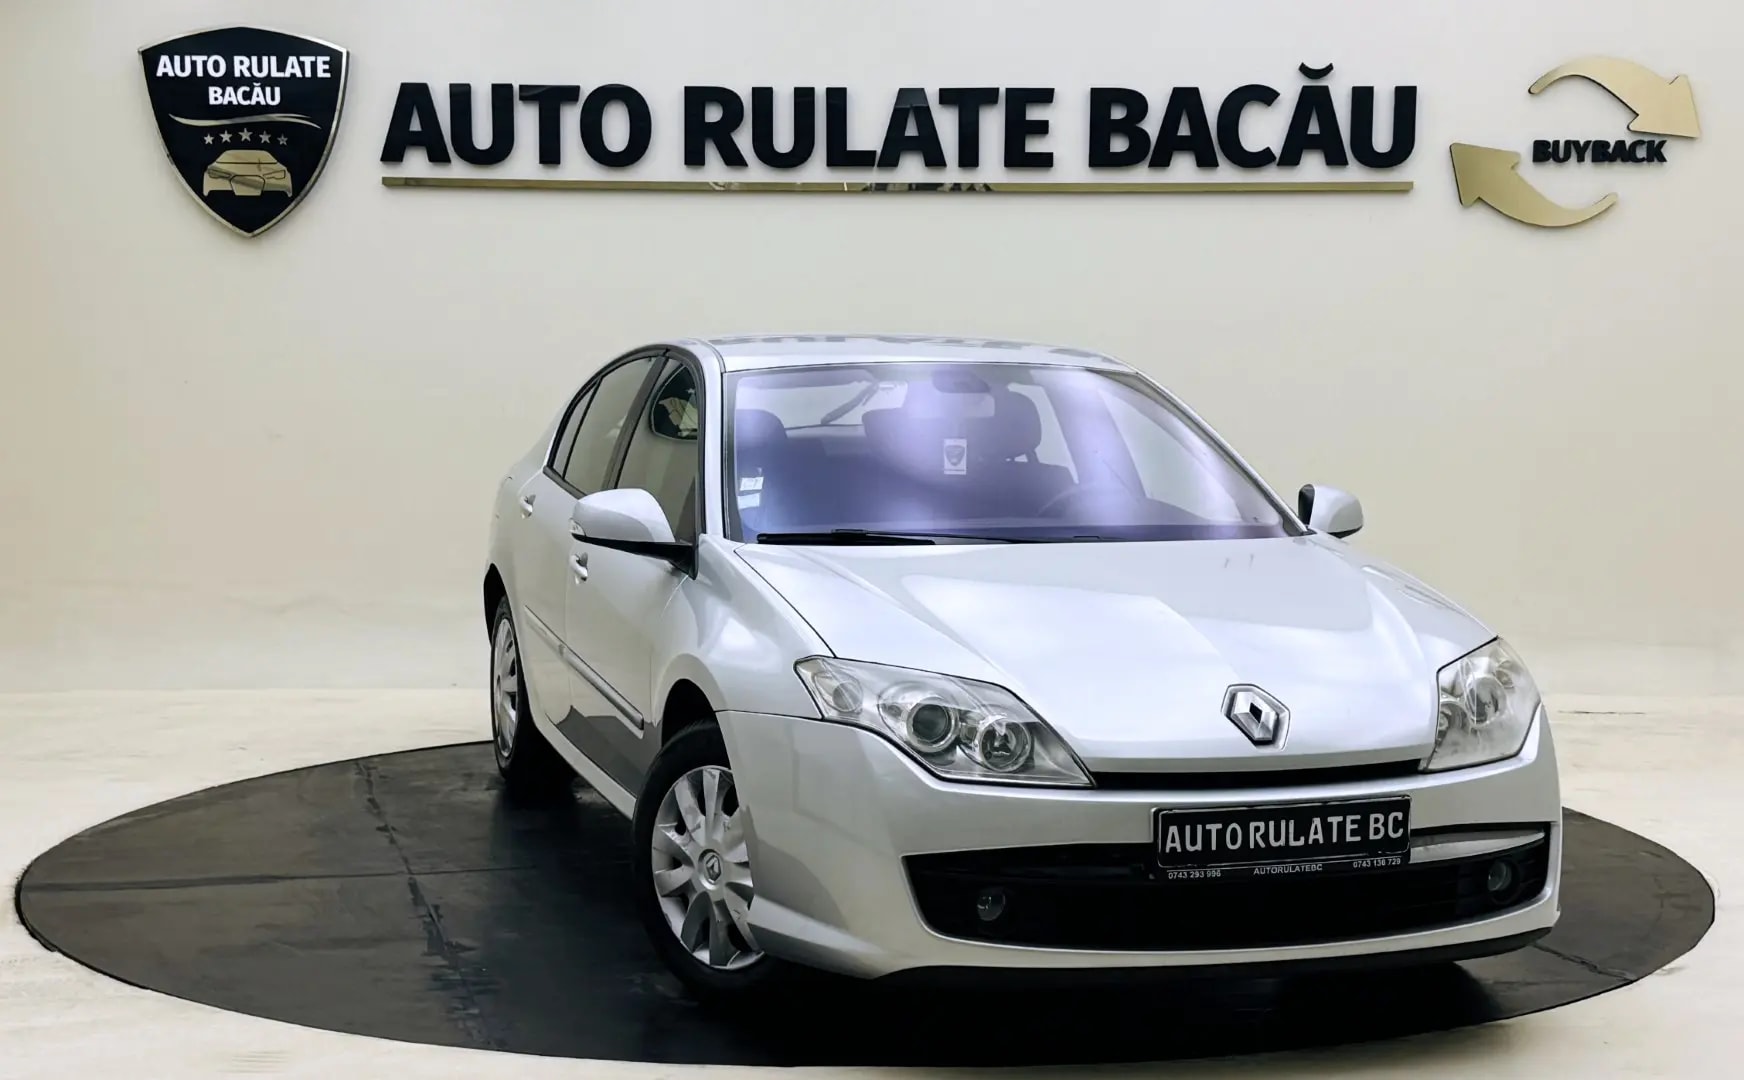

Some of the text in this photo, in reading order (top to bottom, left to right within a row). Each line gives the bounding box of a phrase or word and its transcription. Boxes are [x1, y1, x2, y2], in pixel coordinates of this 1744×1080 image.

[156, 54, 331, 79] AUTO RULATE
[208, 82, 281, 106] BACĂU
[380, 62, 1418, 169] AUTO RULATE BACĂU
[1532, 139, 1668, 164] BUYBACK
[1165, 811, 1404, 853] AUTO RULATE BC
[1168, 871, 1188, 879] 0743
[1253, 863, 1323, 875] AUTORULATEBC
[1352, 860, 1371, 868] 0743
